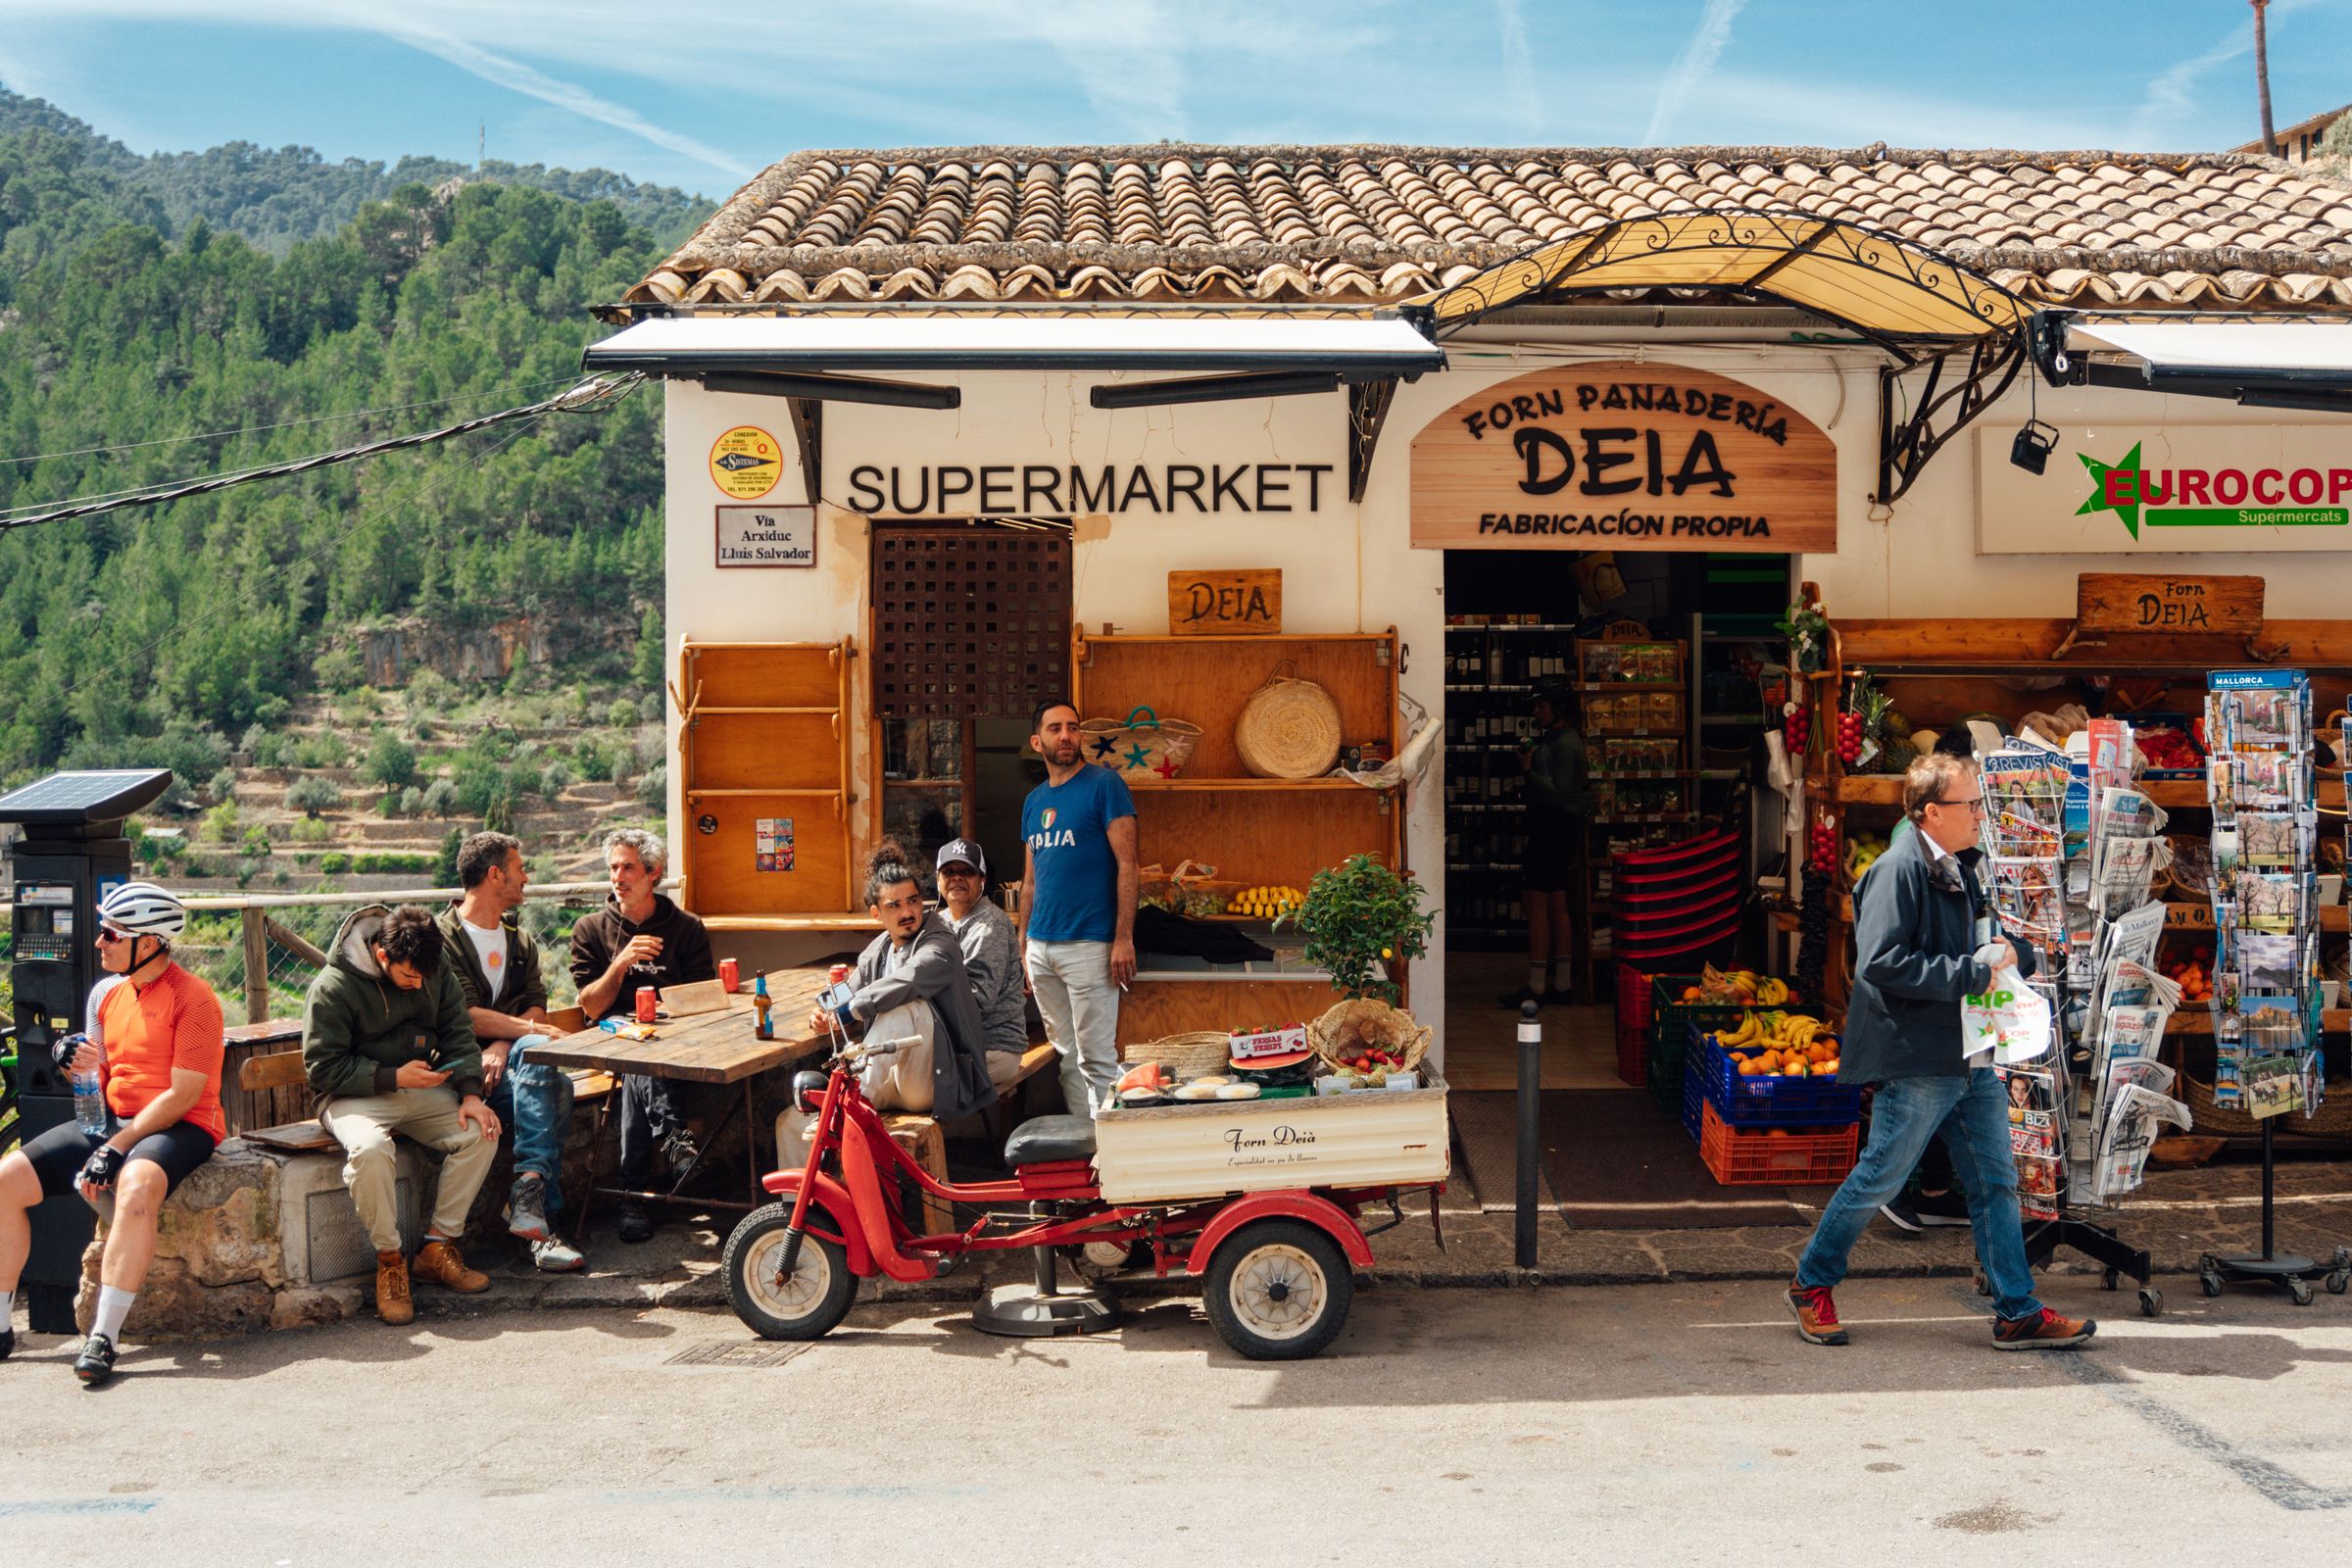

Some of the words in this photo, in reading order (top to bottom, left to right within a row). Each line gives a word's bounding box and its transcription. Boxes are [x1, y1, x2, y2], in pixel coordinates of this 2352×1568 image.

[1461, 389, 1564, 440] FORN
[1576, 383, 1788, 447] PANADERÍA
[1513, 427, 1737, 498] DEIA
[847, 465, 1334, 514] SUPERMARKET
[1672, 515, 1771, 537] PROPIA
[2238, 511, 2341, 526] Supermercats
[741, 530, 792, 541] Arxiduc
[756, 547, 811, 559] Salvador
[2215, 676, 2263, 685] MALLORCA
[952, 842, 967, 855] NY
[1224, 1129, 1266, 1152] Forn
[1274, 1125, 1316, 1146] Deià
